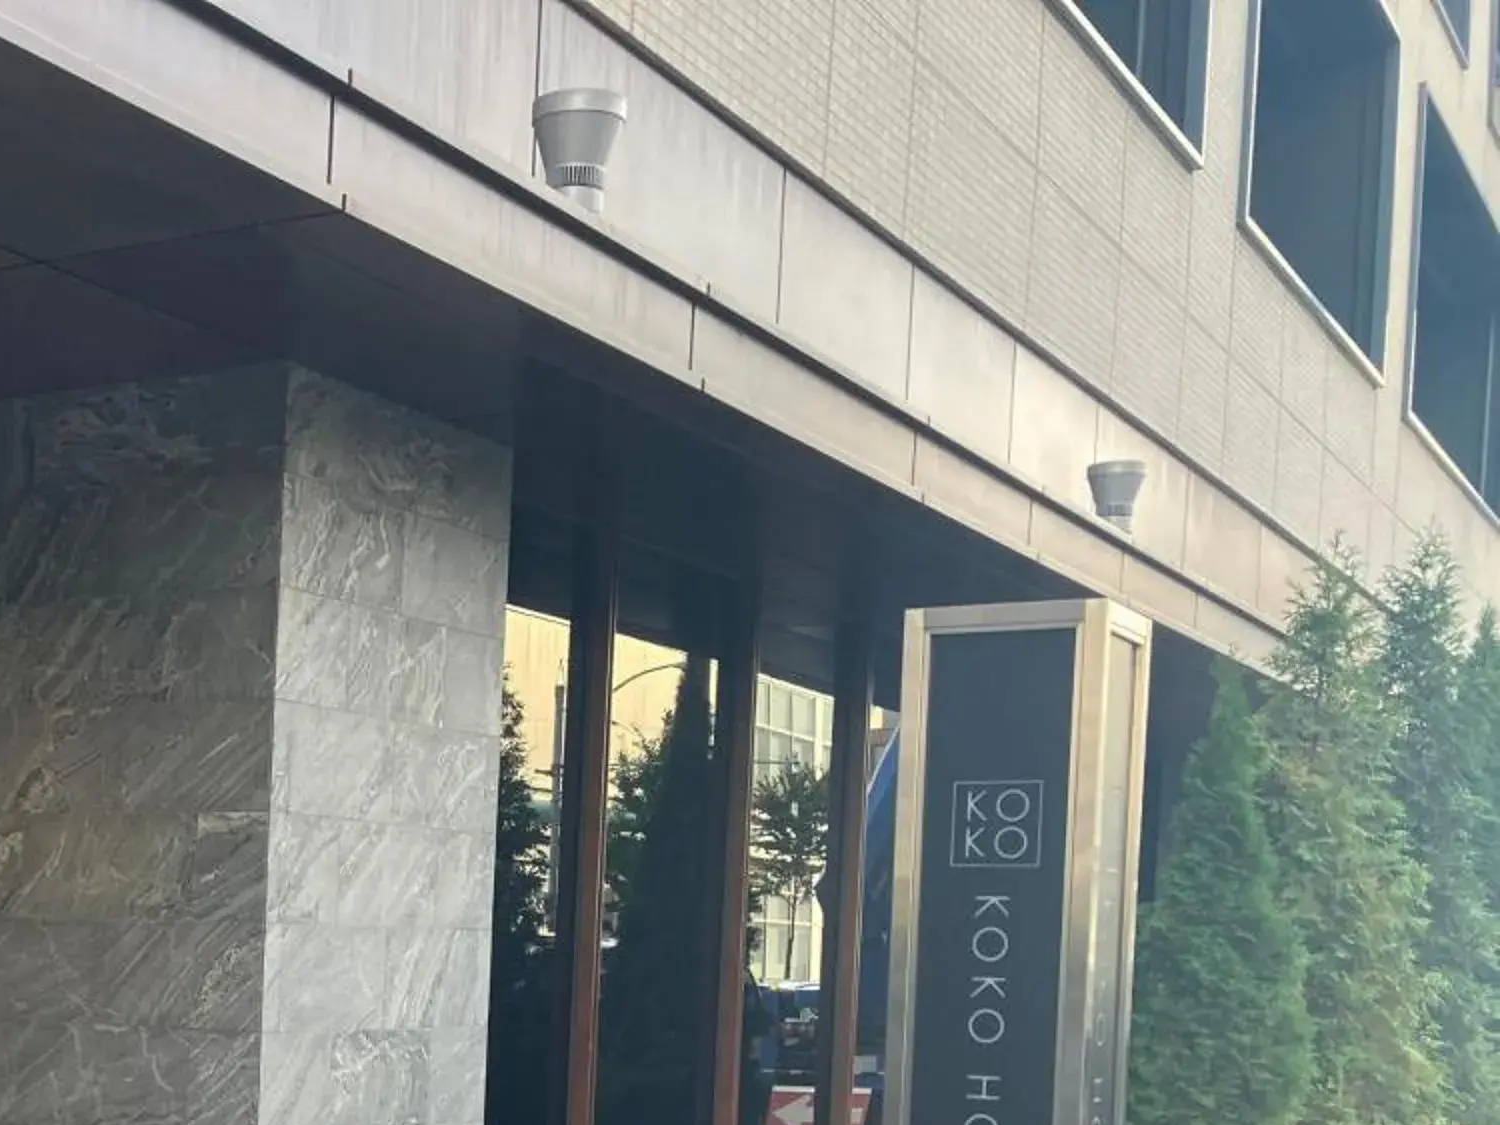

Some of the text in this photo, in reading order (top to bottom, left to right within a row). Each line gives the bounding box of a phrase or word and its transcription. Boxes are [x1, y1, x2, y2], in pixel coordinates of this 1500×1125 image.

[967, 788, 1030, 822] KO
[965, 826, 1028, 859] KO
[968, 895, 1010, 1044] KOKO
